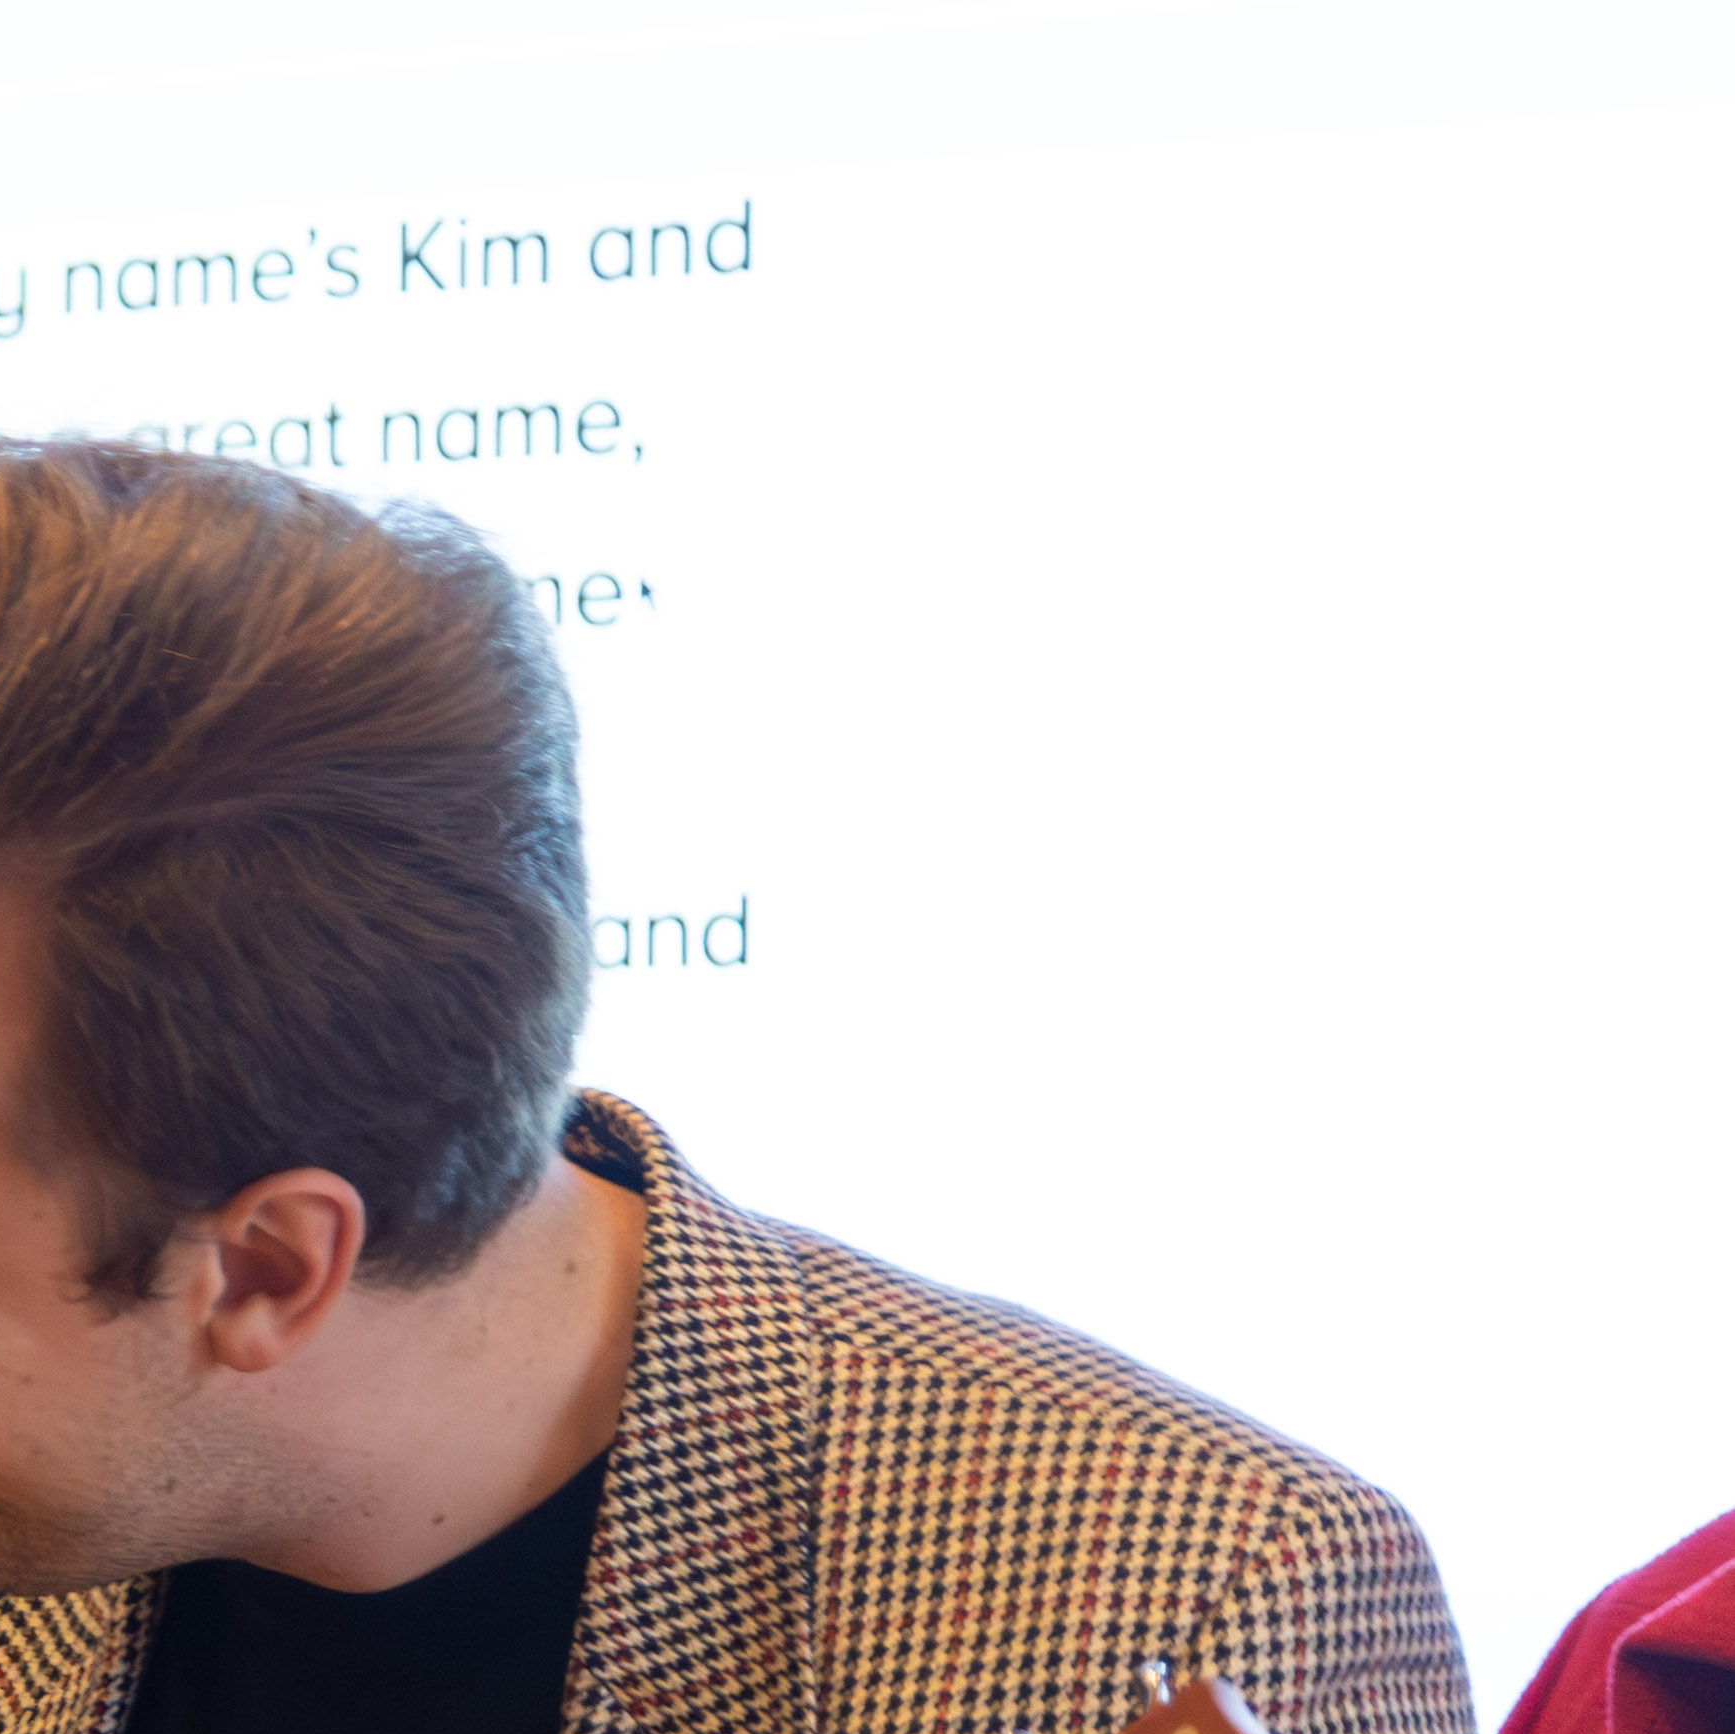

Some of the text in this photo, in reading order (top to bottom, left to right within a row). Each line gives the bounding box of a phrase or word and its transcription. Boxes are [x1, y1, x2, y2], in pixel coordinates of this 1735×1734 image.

[65, 227, 361, 312] name's
[401, 220, 549, 292] Kim
[589, 200, 753, 282] and
[383, 402, 645, 463] name,
[590, 894, 749, 968] and
